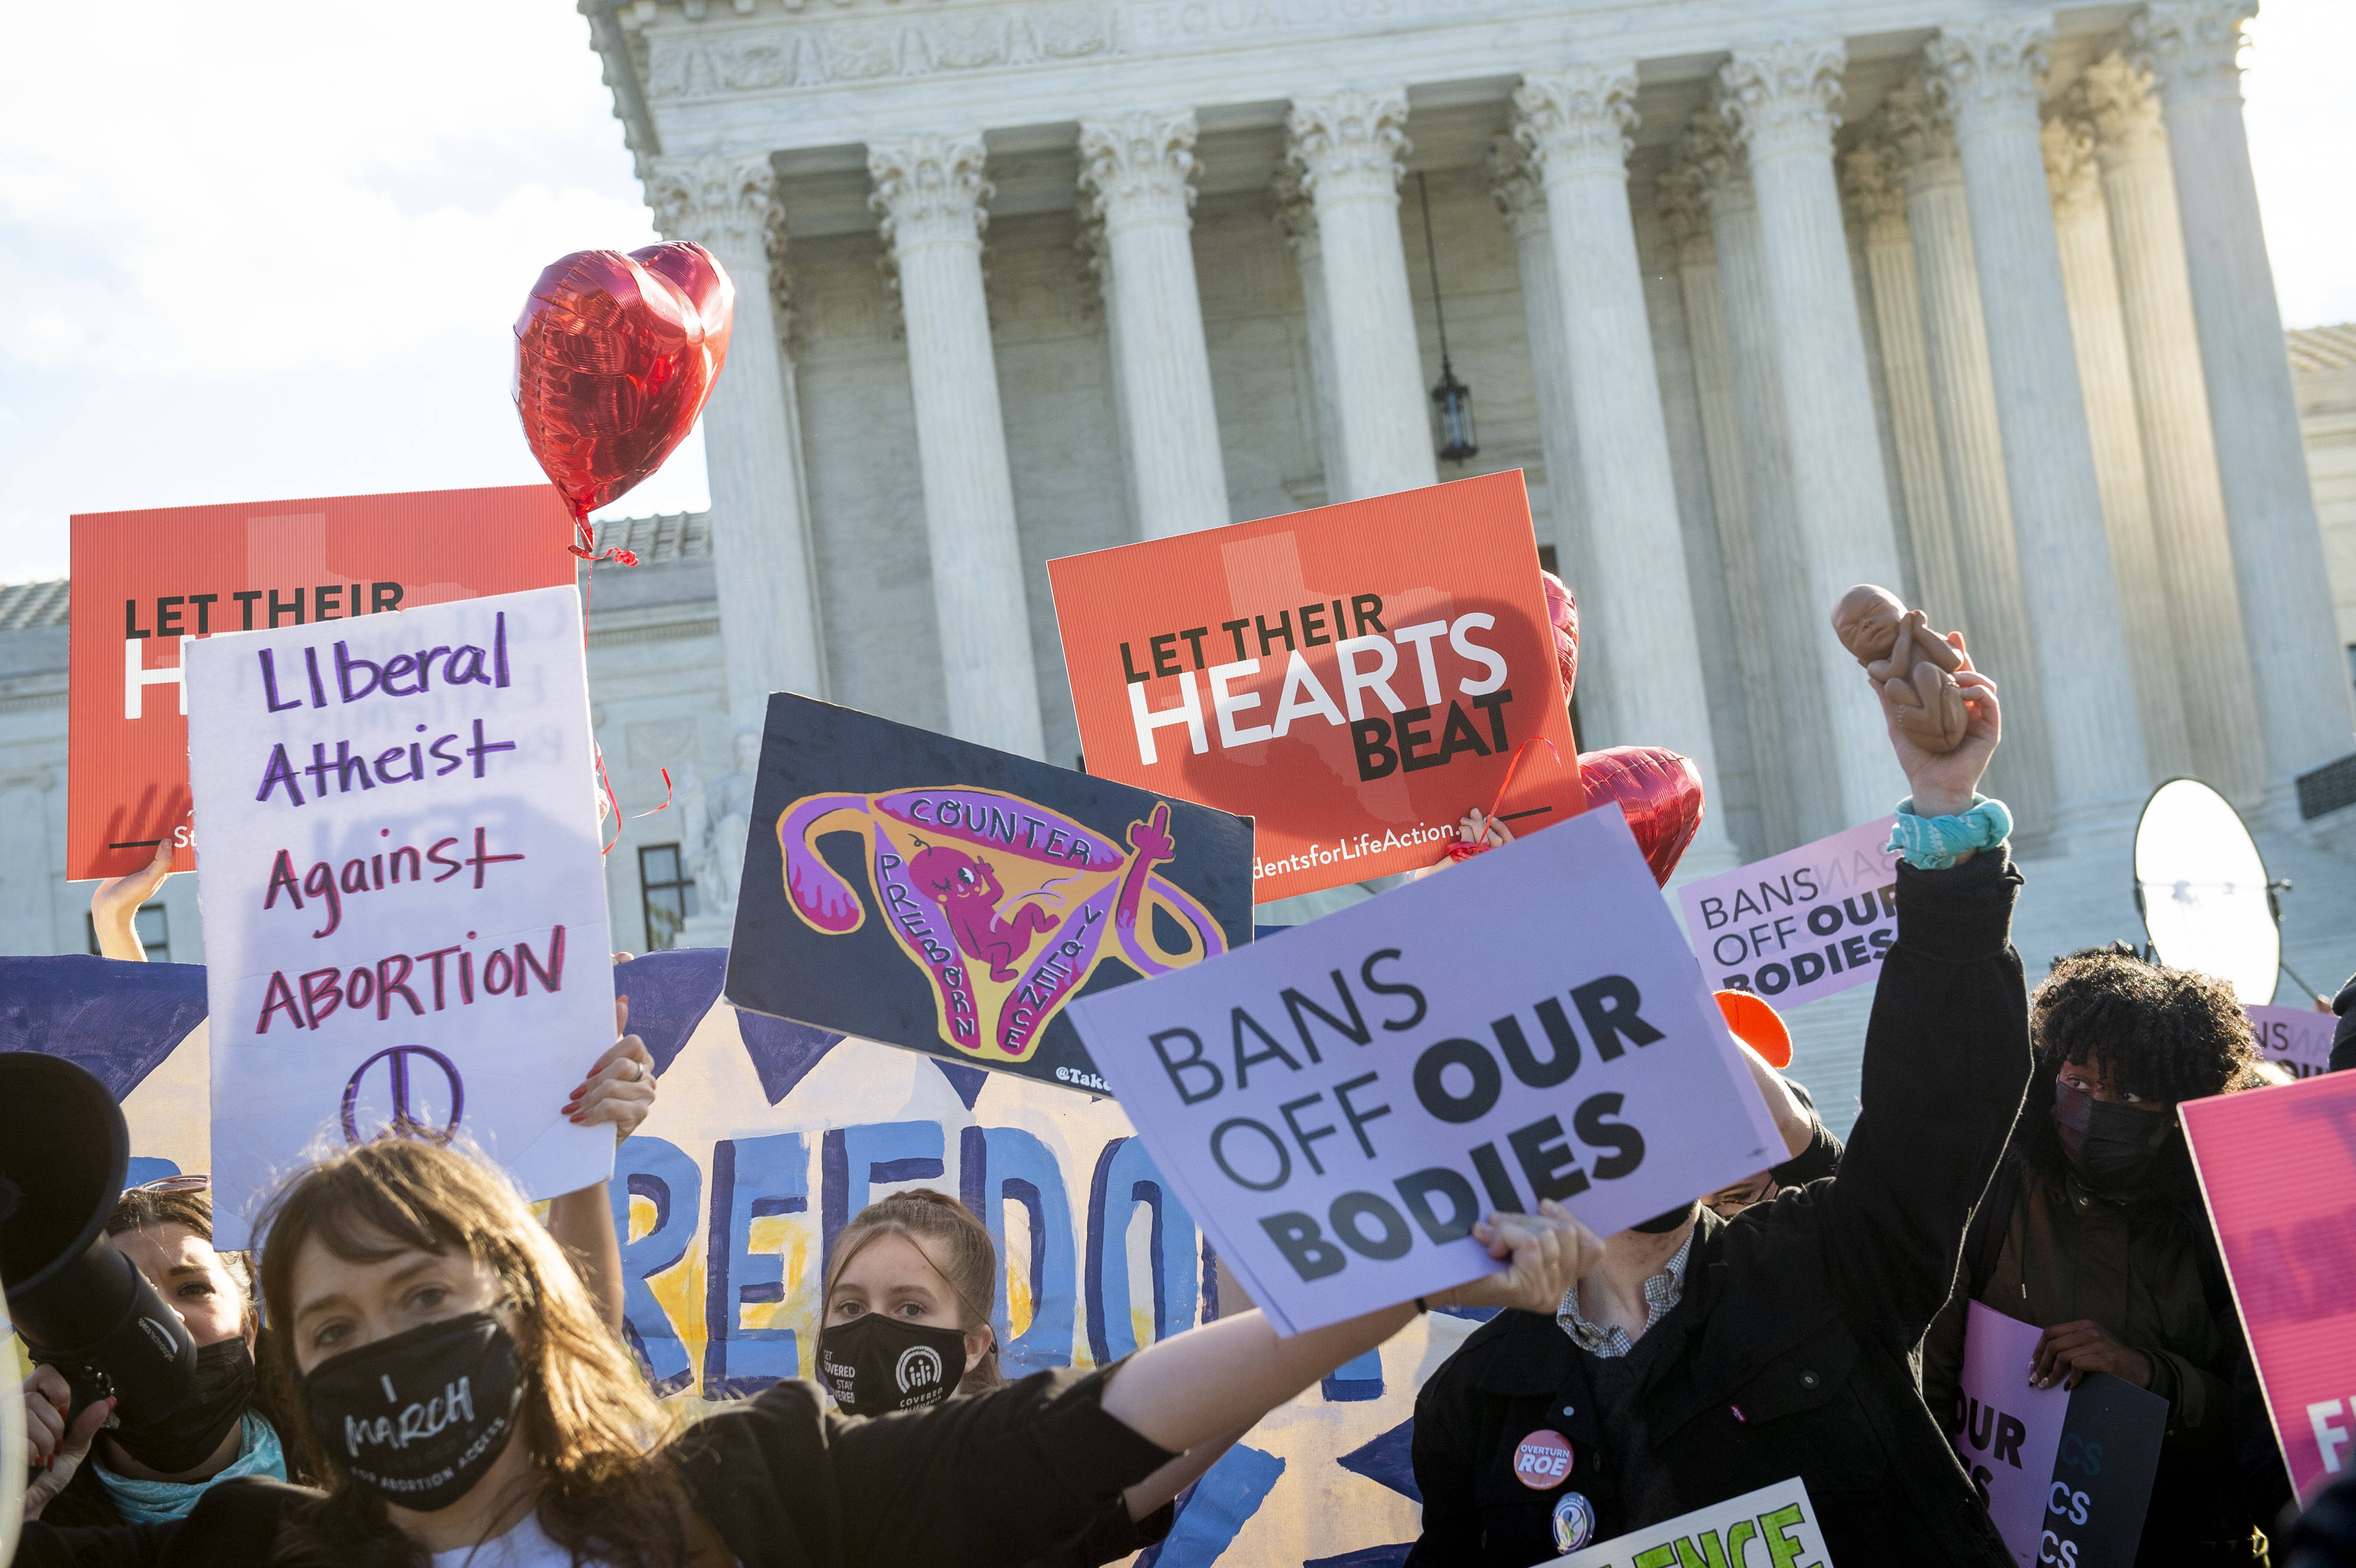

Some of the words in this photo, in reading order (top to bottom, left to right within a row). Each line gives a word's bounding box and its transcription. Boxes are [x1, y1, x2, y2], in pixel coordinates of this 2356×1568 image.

[125, 593, 218, 639] LET
[233, 582, 404, 630] THEIR
[1120, 627, 1208, 683] LET
[1222, 593, 1388, 661] THEIR
[125, 634, 196, 720] H
[1127, 612, 1507, 765] HEARTS
[256, 718, 516, 807] Atheist
[1350, 689, 1513, 782] BEAT
[174, 825, 197, 848] St
[910, 798, 1091, 866] COUNTER
[1253, 822, 1461, 880] dentsforLifeAction.
[263, 826, 525, 939] Against
[1700, 868, 1819, 930] BANS
[881, 854, 975, 1039] PREBORN
[1713, 916, 1796, 966] OFF
[1005, 904, 1104, 1049] VIOLENCE
[1149, 948, 1427, 1106] BANS
[1210, 1071, 1391, 1190] OFF
[1413, 974, 1666, 1123] OUR
[1259, 1091, 1645, 1282] BODIES
[344, 1375, 475, 1458] MARCH
[380, 1374, 398, 1404] I
[834, 1389, 855, 1404] VERED
[836, 1379, 853, 1391] STAY
[900, 1386, 943, 1408] COVERED
[380, 1467, 455, 1493] ABORTION
[458, 1417, 505, 1470] ACCESS
[1518, 1454, 1568, 1477] ROE
[1520, 1444, 1570, 1458] OVERTURN
[2062, 1432, 2103, 1477] CS
[2306, 1395, 2356, 1474] F
[2047, 1481, 2091, 1526] CS
[2038, 1530, 2079, 1568] CS
